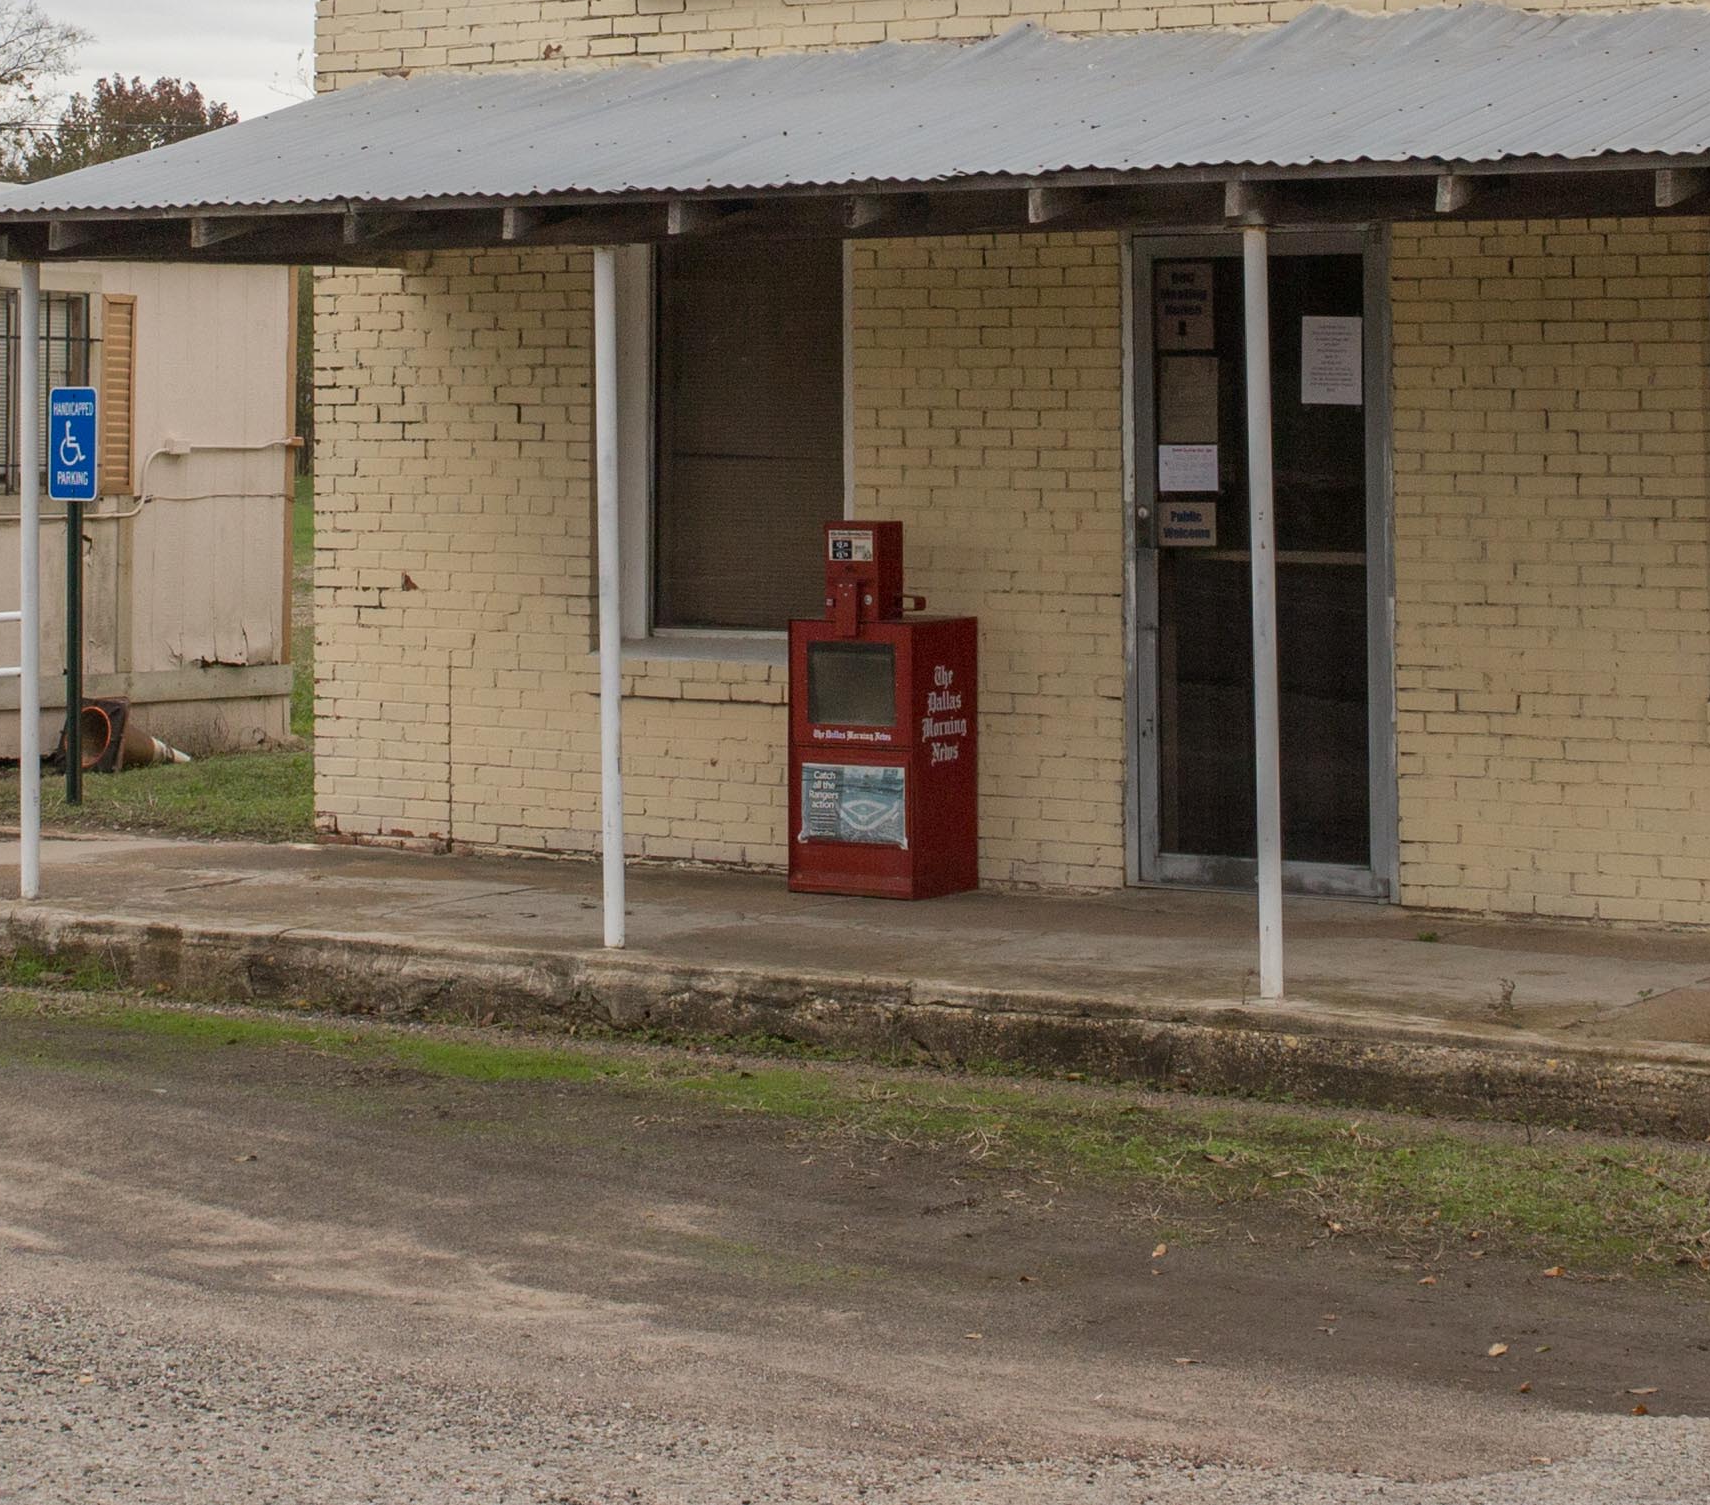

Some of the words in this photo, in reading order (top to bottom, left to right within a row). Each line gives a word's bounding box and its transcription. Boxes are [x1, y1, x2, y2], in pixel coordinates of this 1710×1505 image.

[53, 402, 94, 416] HANDICAPPED
[57, 471, 89, 486] PARKING
[933, 665, 953, 689] The
[927, 690, 962, 716] Dallas
[921, 716, 967, 744] Morning
[931, 741, 959, 768] News
[813, 770, 836, 780] Catch
[813, 779, 822, 789] all
[823, 780, 836, 790] the
[809, 789, 839, 802] Rangers
[811, 800, 835, 809] action
